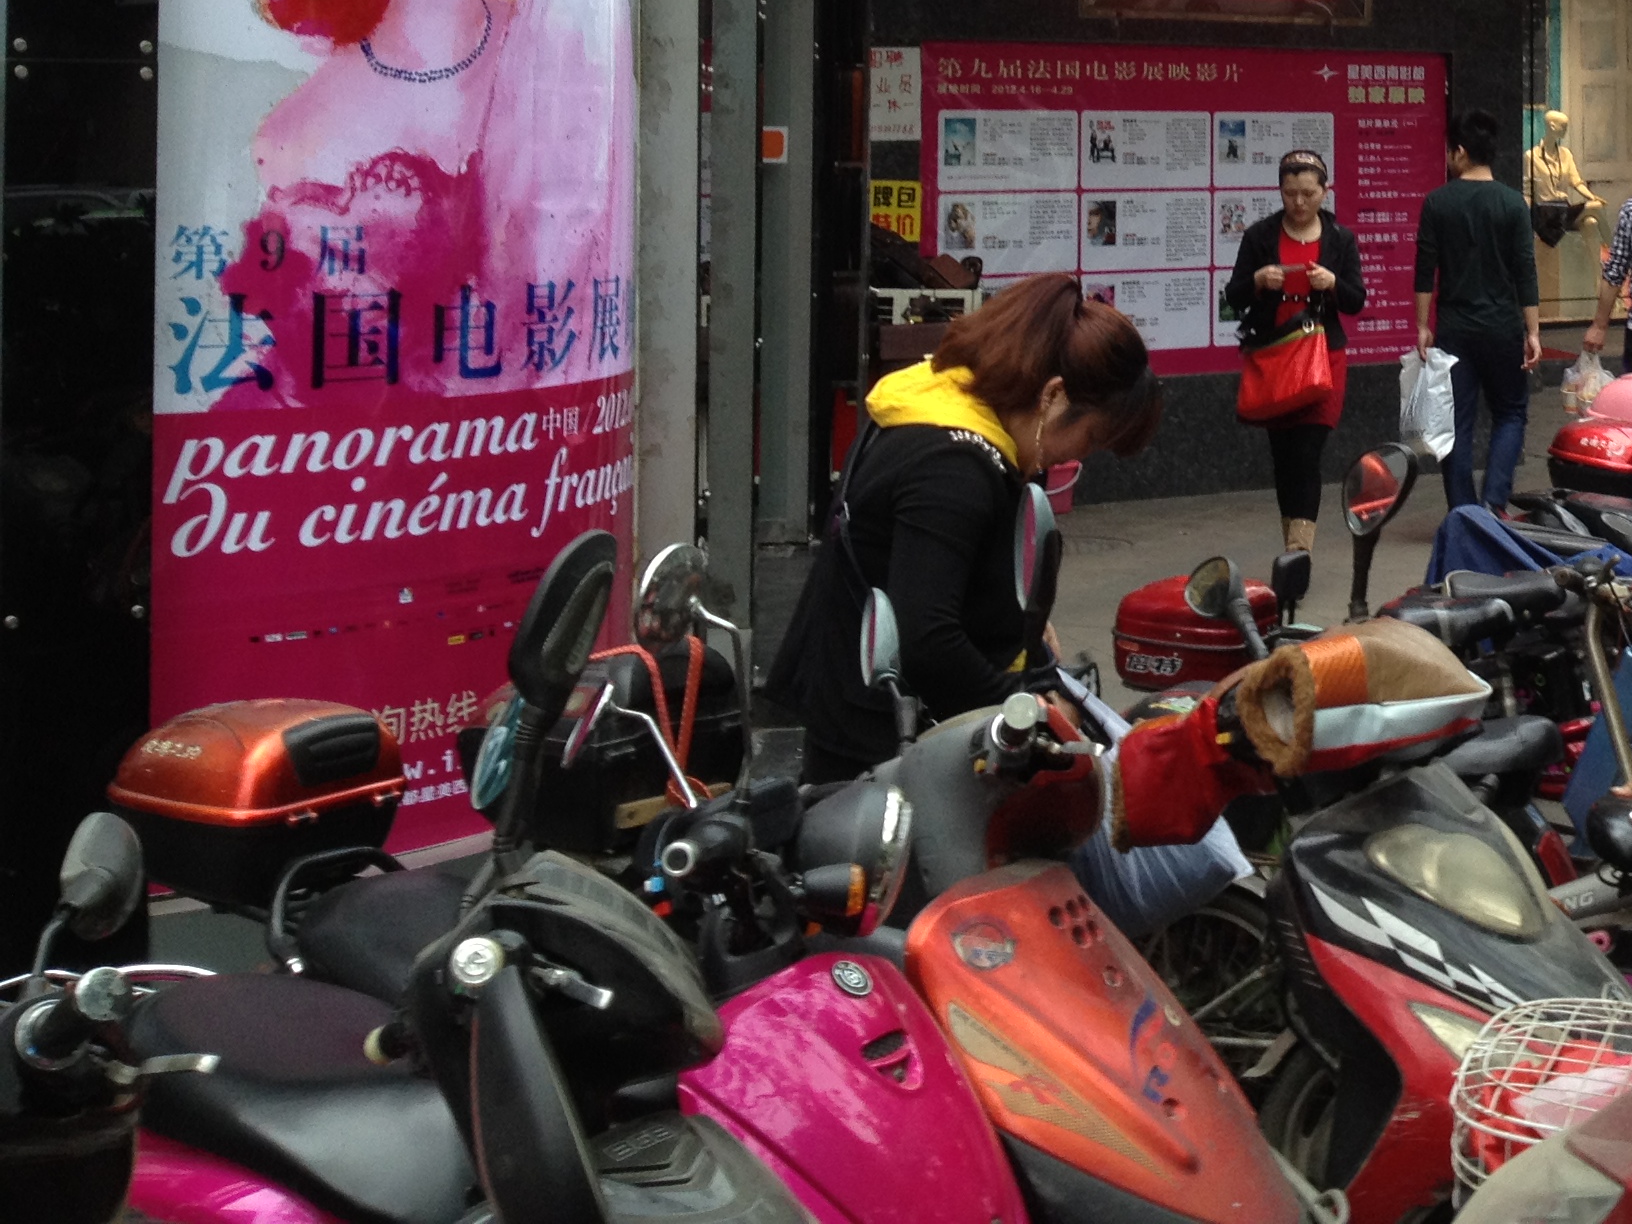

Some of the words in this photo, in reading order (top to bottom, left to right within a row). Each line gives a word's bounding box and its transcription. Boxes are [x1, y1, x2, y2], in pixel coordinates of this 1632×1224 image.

[938, 57, 1242, 83] 第九届法国电影展映影片
[873, 185, 916, 208] 牌包
[168, 221, 367, 280] 第9届
[168, 275, 634, 396] 法国电影展
[163, 410, 540, 504] panorama
[542, 407, 580, 441] 中国
[170, 481, 276, 558] du
[298, 473, 530, 548] cinéma
